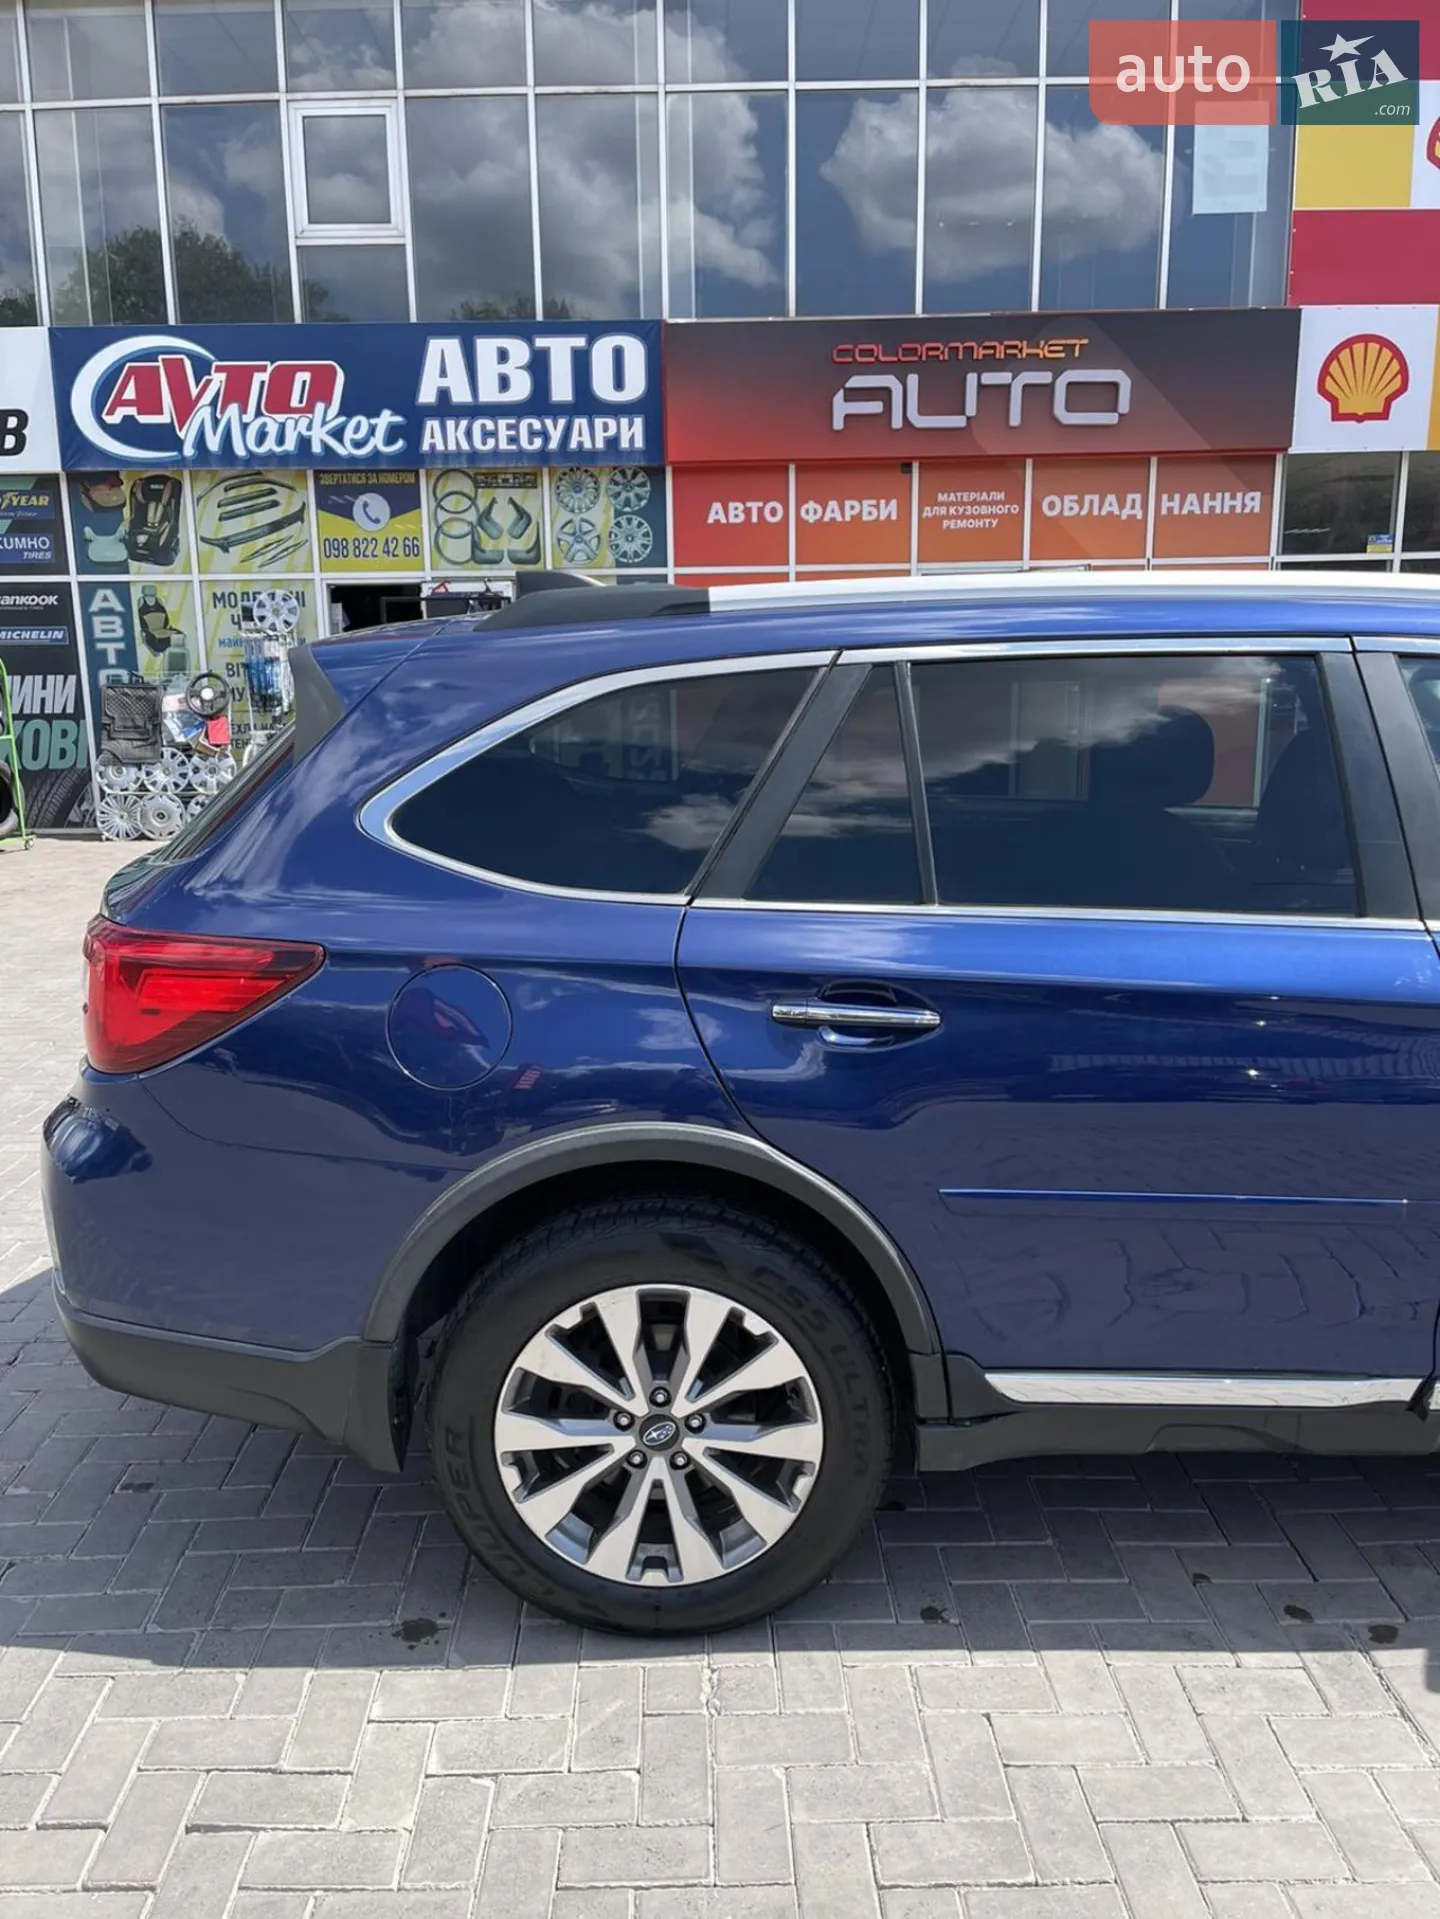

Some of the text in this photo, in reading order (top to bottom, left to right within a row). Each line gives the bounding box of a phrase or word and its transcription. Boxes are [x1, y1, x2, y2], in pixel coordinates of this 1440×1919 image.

[832, 338, 1089, 363] COLORMARKET
[417, 334, 647, 404] АВТО
[832, 369, 1132, 431] AUTO
[182, 401, 405, 457] Market
[421, 416, 643, 451] АКСЕСУАРИ
[937, 490, 1005, 502] МАТЕРІАЛИ
[1042, 491, 1261, 520] ОБЛАД НАННЯ
[707, 498, 898, 524] АВТО ФАРБИ
[922, 503, 1019, 518] ДЛЯ КУЗОВНОГО
[942, 517, 999, 530] РЕМОНТУ
[323, 536, 420, 559] 098 822 42 66
[7, 674, 77, 715] ИНИ
